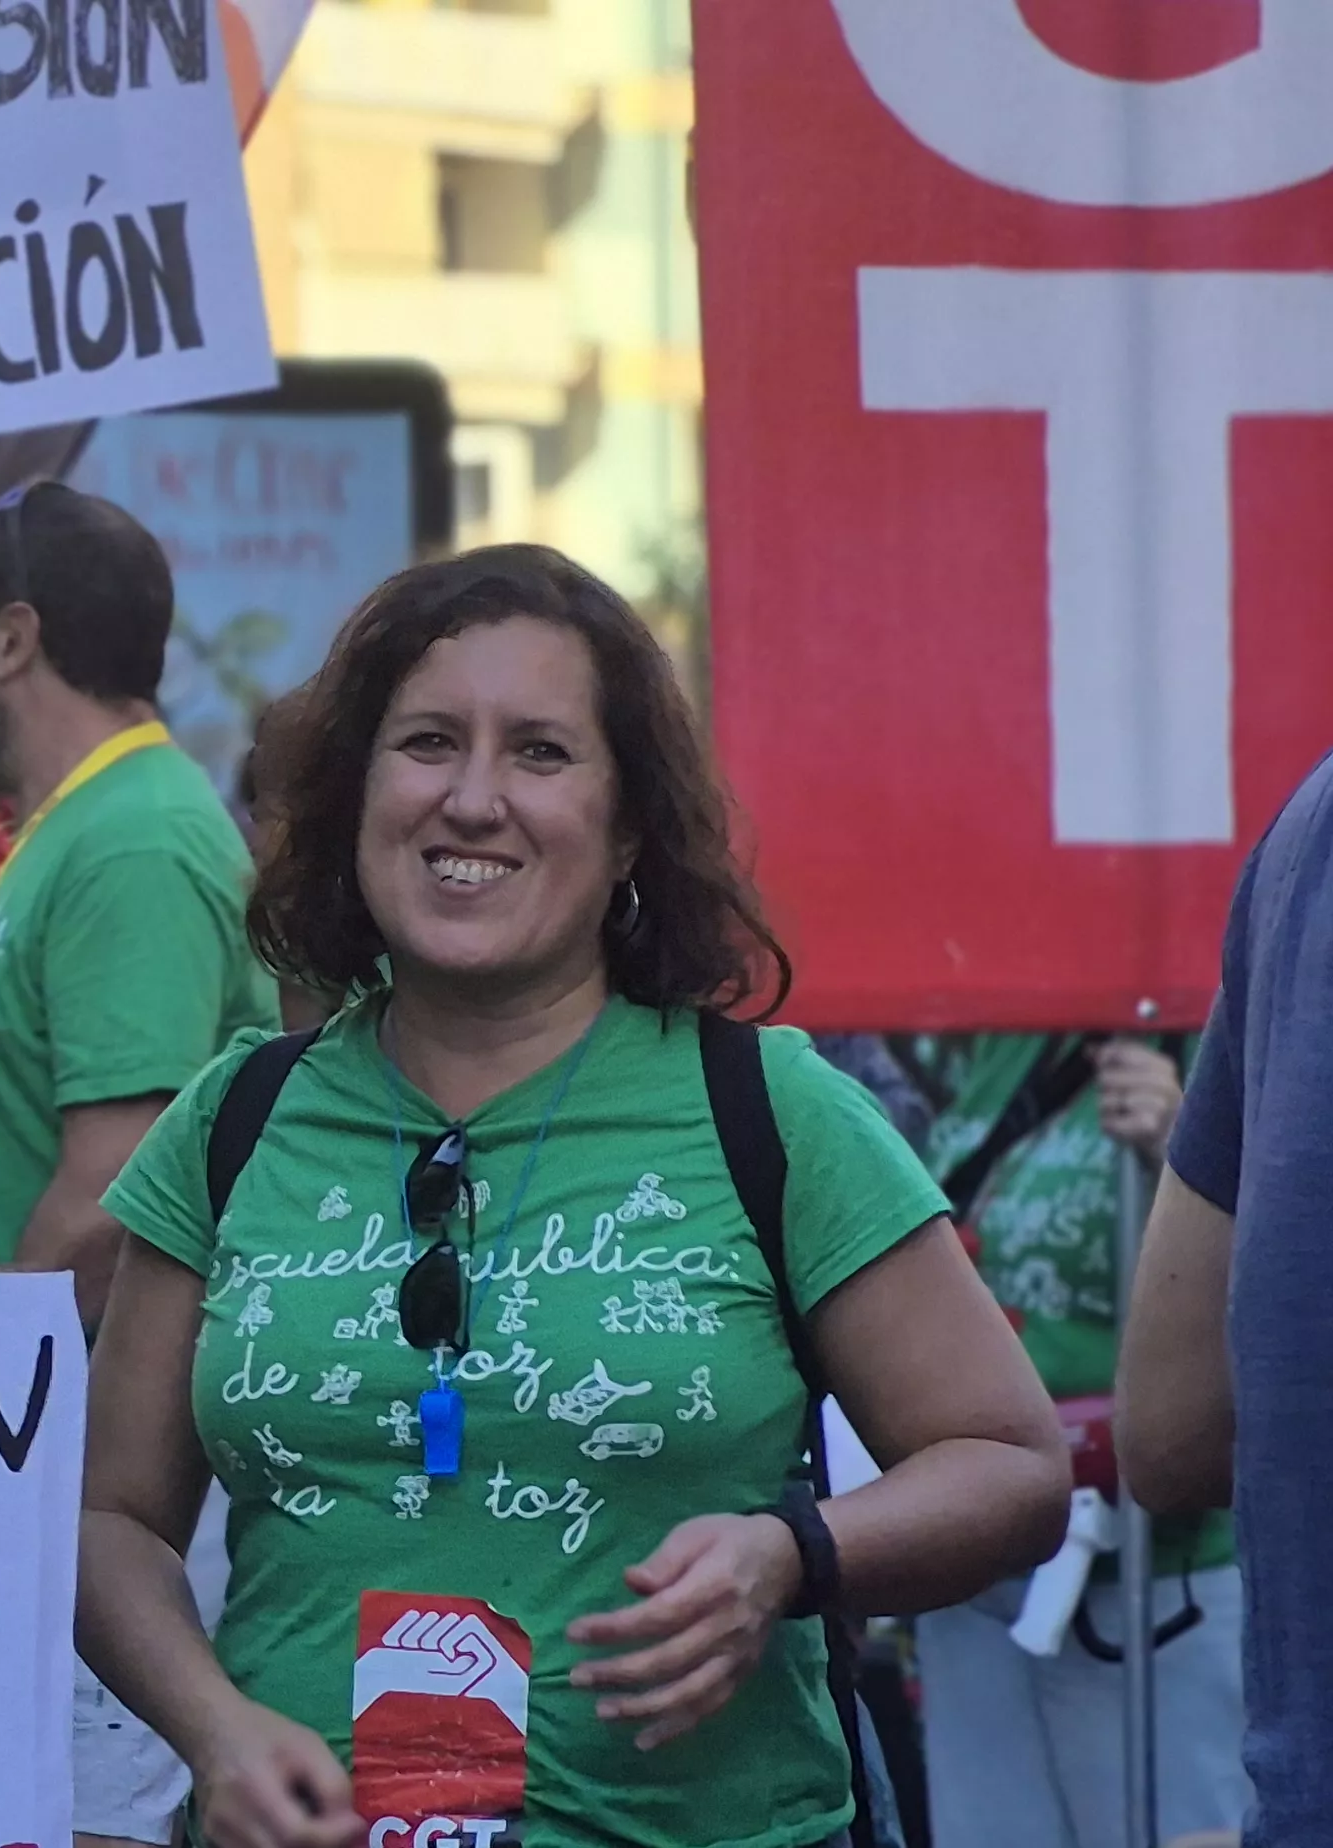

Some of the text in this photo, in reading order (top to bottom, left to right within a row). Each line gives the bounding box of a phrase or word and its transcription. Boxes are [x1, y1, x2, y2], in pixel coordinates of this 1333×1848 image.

[223, 1342, 300, 1403] de
[486, 1461, 606, 1556] toz
[369, 1815, 507, 1848] CGT
